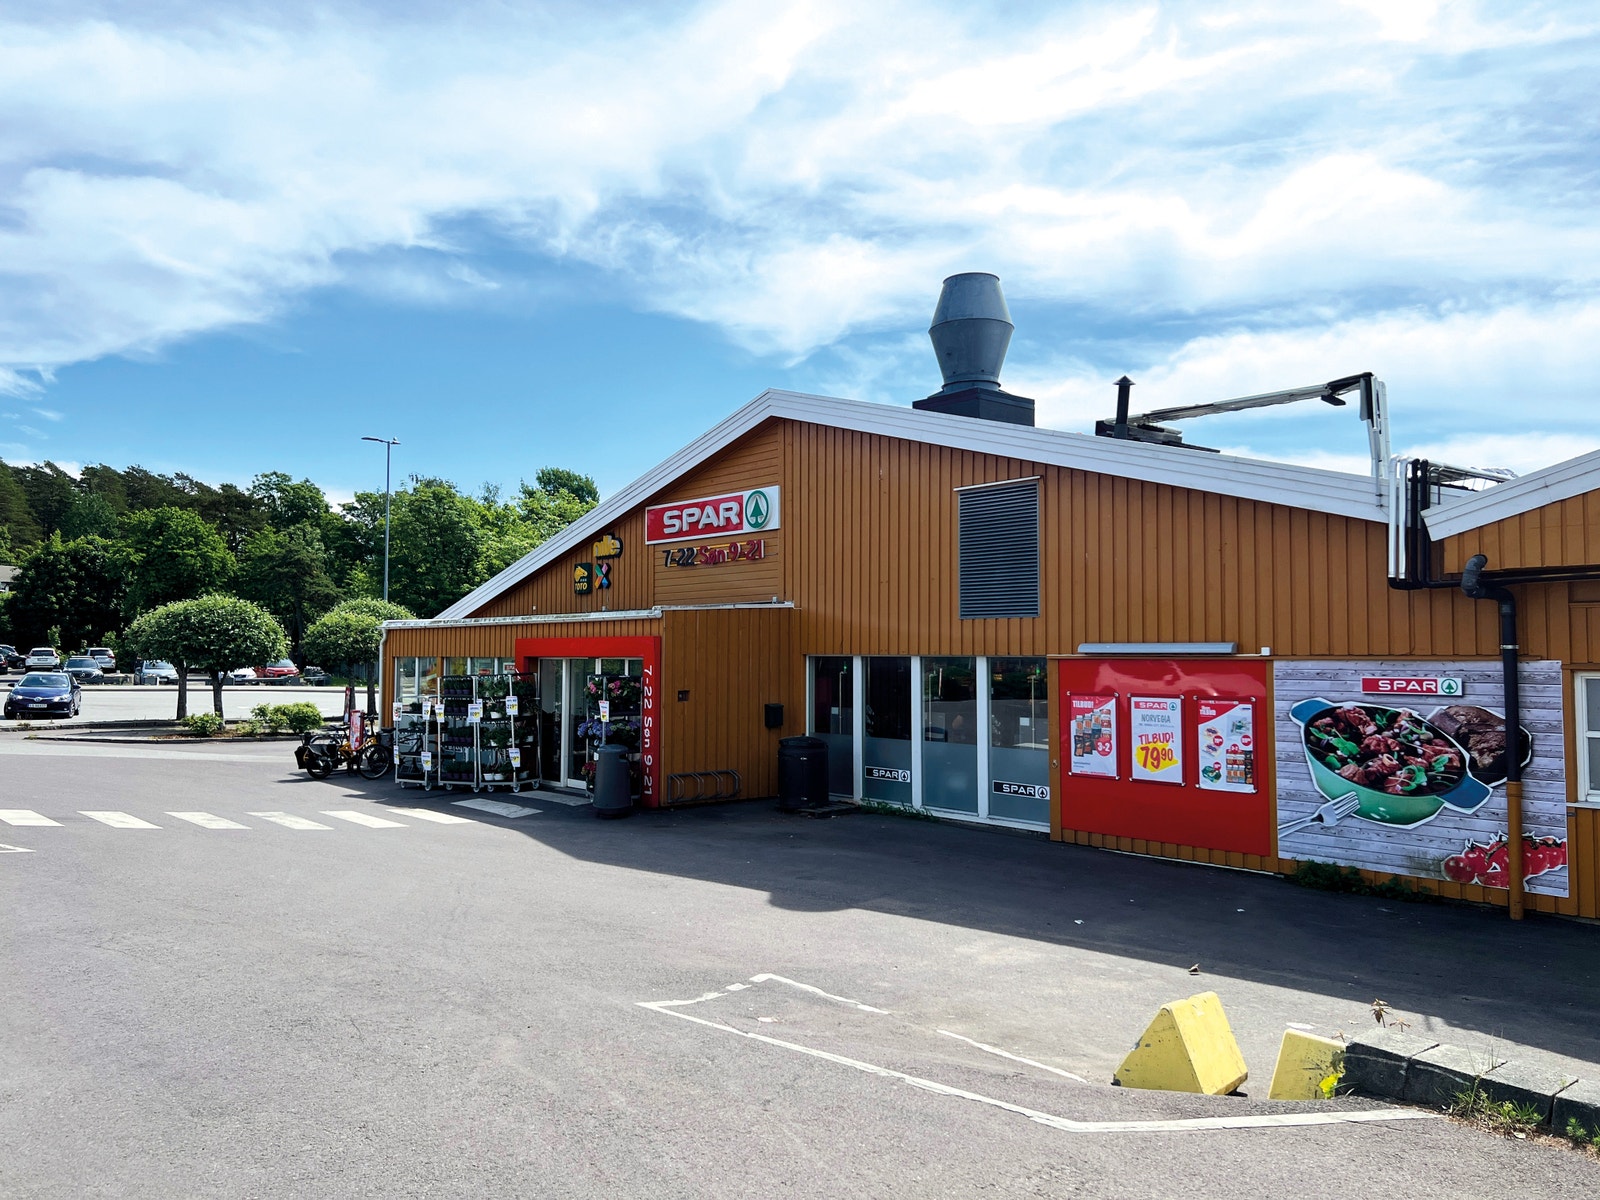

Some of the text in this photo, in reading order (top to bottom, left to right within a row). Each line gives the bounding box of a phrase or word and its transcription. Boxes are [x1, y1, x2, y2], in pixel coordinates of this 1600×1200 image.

[663, 501, 740, 534] SPAR
[662, 547, 697, 567] 7-22
[729, 539, 765, 561] 9-21
[1378, 680, 1437, 691] SPAR
[1141, 714, 1171, 723] NORVEGIA
[644, 665, 653, 795] 7-22 Søn 9-21
[1138, 732, 1174, 745] TILBUD!
[872, 769, 899, 779] SPAR
[1002, 784, 1035, 796] SPAR
